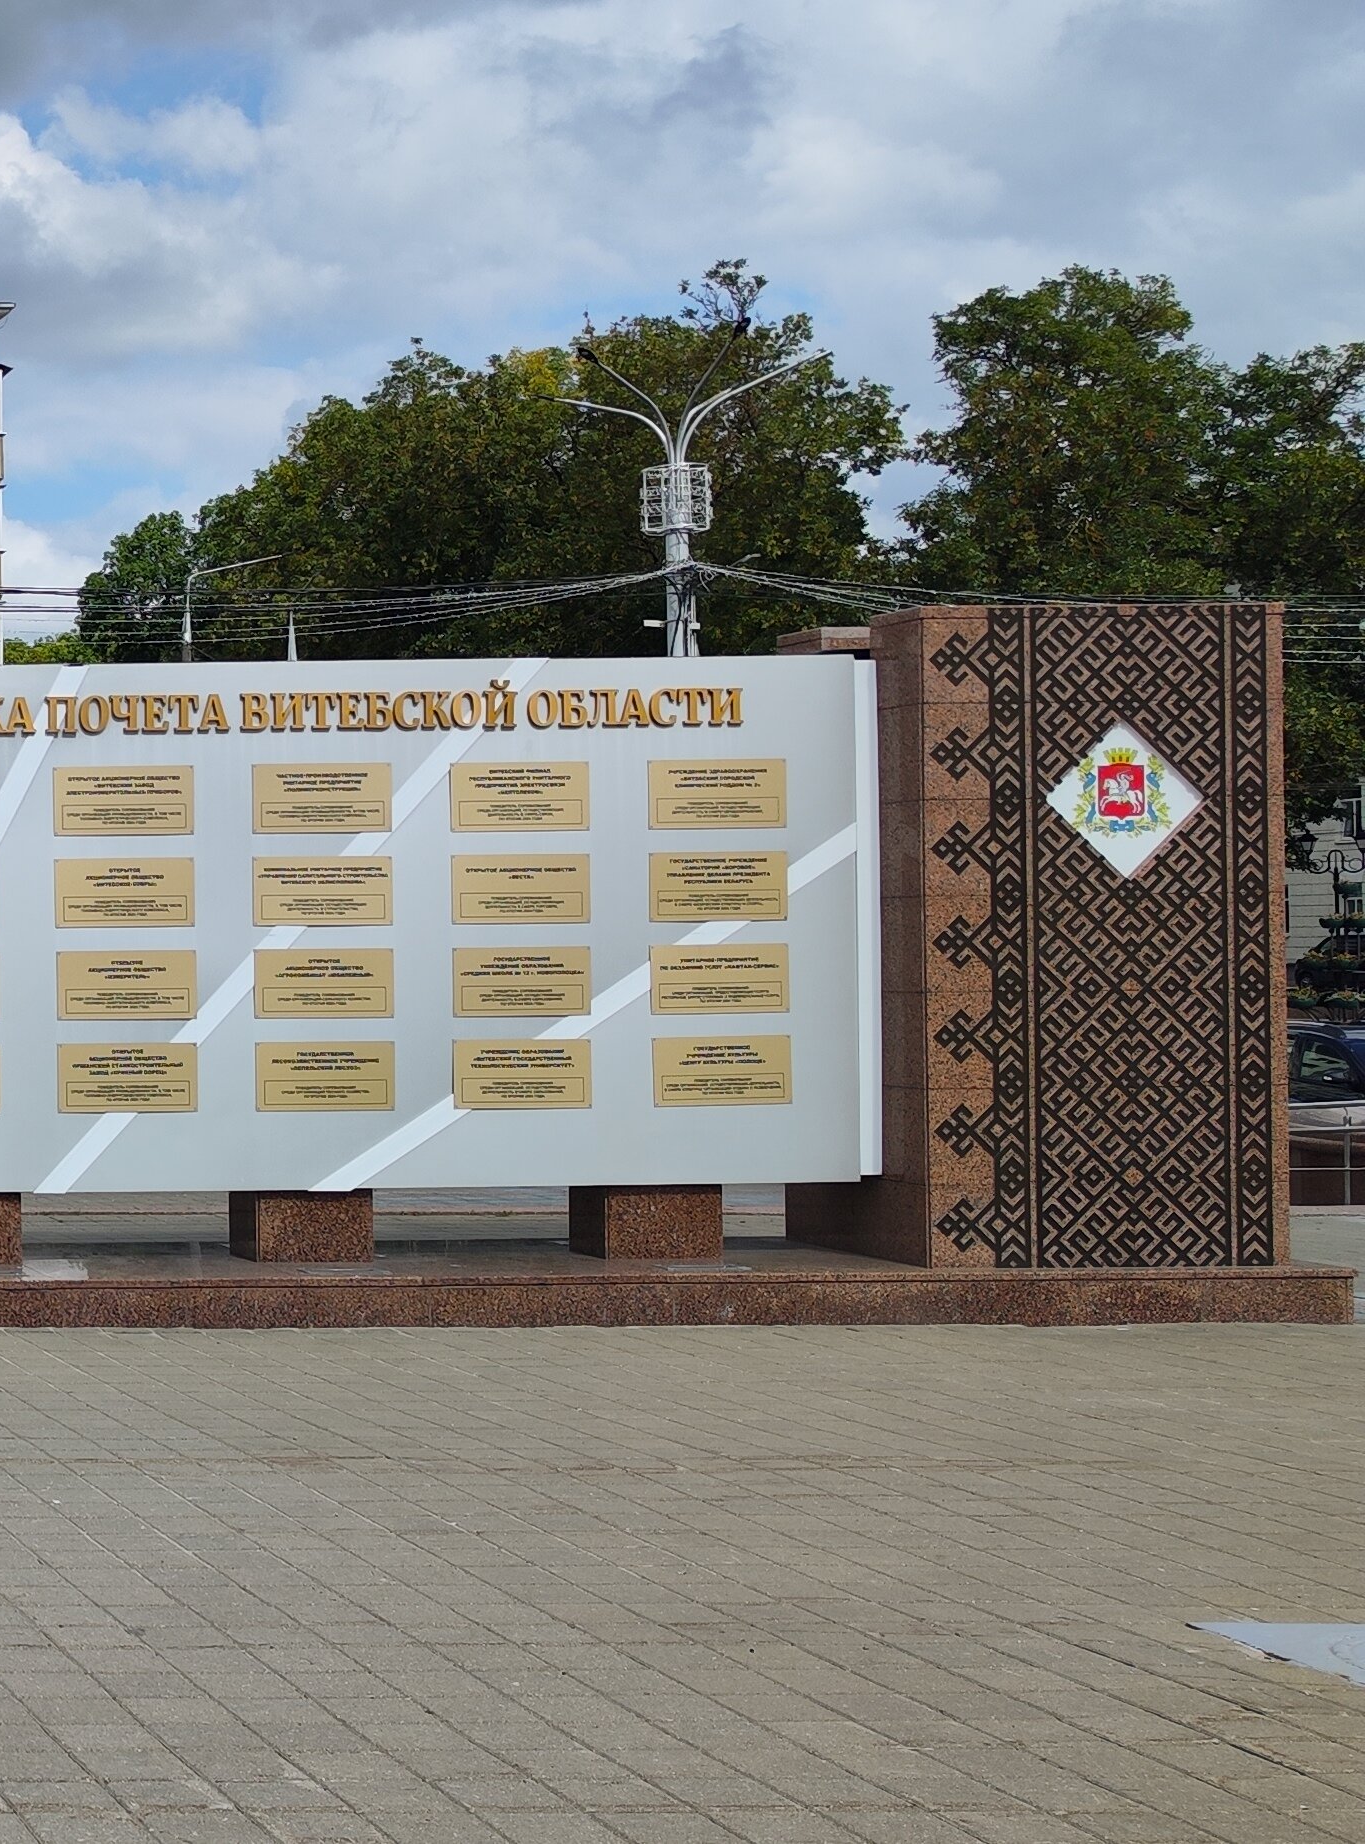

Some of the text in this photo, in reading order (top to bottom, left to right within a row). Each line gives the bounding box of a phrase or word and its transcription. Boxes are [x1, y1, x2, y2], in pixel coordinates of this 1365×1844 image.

[44, 693, 230, 738] ПОЧЕТА
[239, 679, 518, 736] ВИТЕБСКОЙ
[526, 687, 744, 731] ОБЛАСТИ
